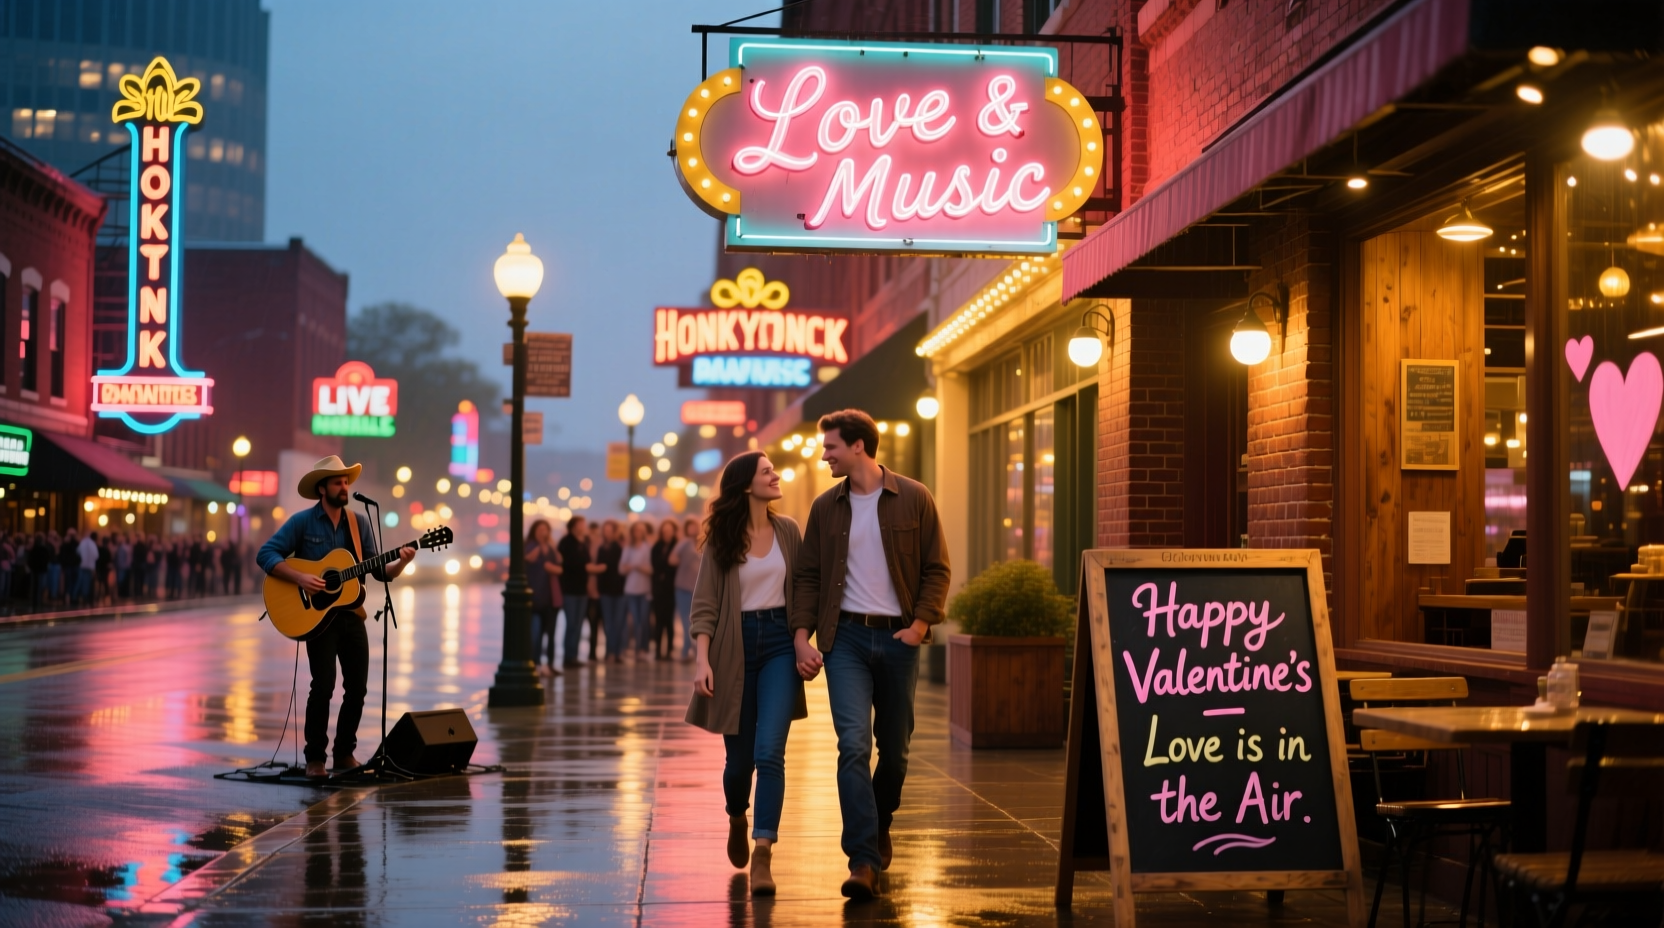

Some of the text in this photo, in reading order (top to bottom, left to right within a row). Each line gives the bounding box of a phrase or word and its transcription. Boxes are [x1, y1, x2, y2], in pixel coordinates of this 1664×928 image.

[733, 66, 1029, 174] Love &
[804, 147, 1051, 229] Music
[140, 126, 170, 368] HOKTNK
[318, 384, 391, 416] LIVE
[1131, 581, 1285, 651] Happy
[1122, 647, 1313, 704] Valentine's
[1143, 714, 1312, 767] Love is in
[1150, 771, 1311, 825] the Air.
